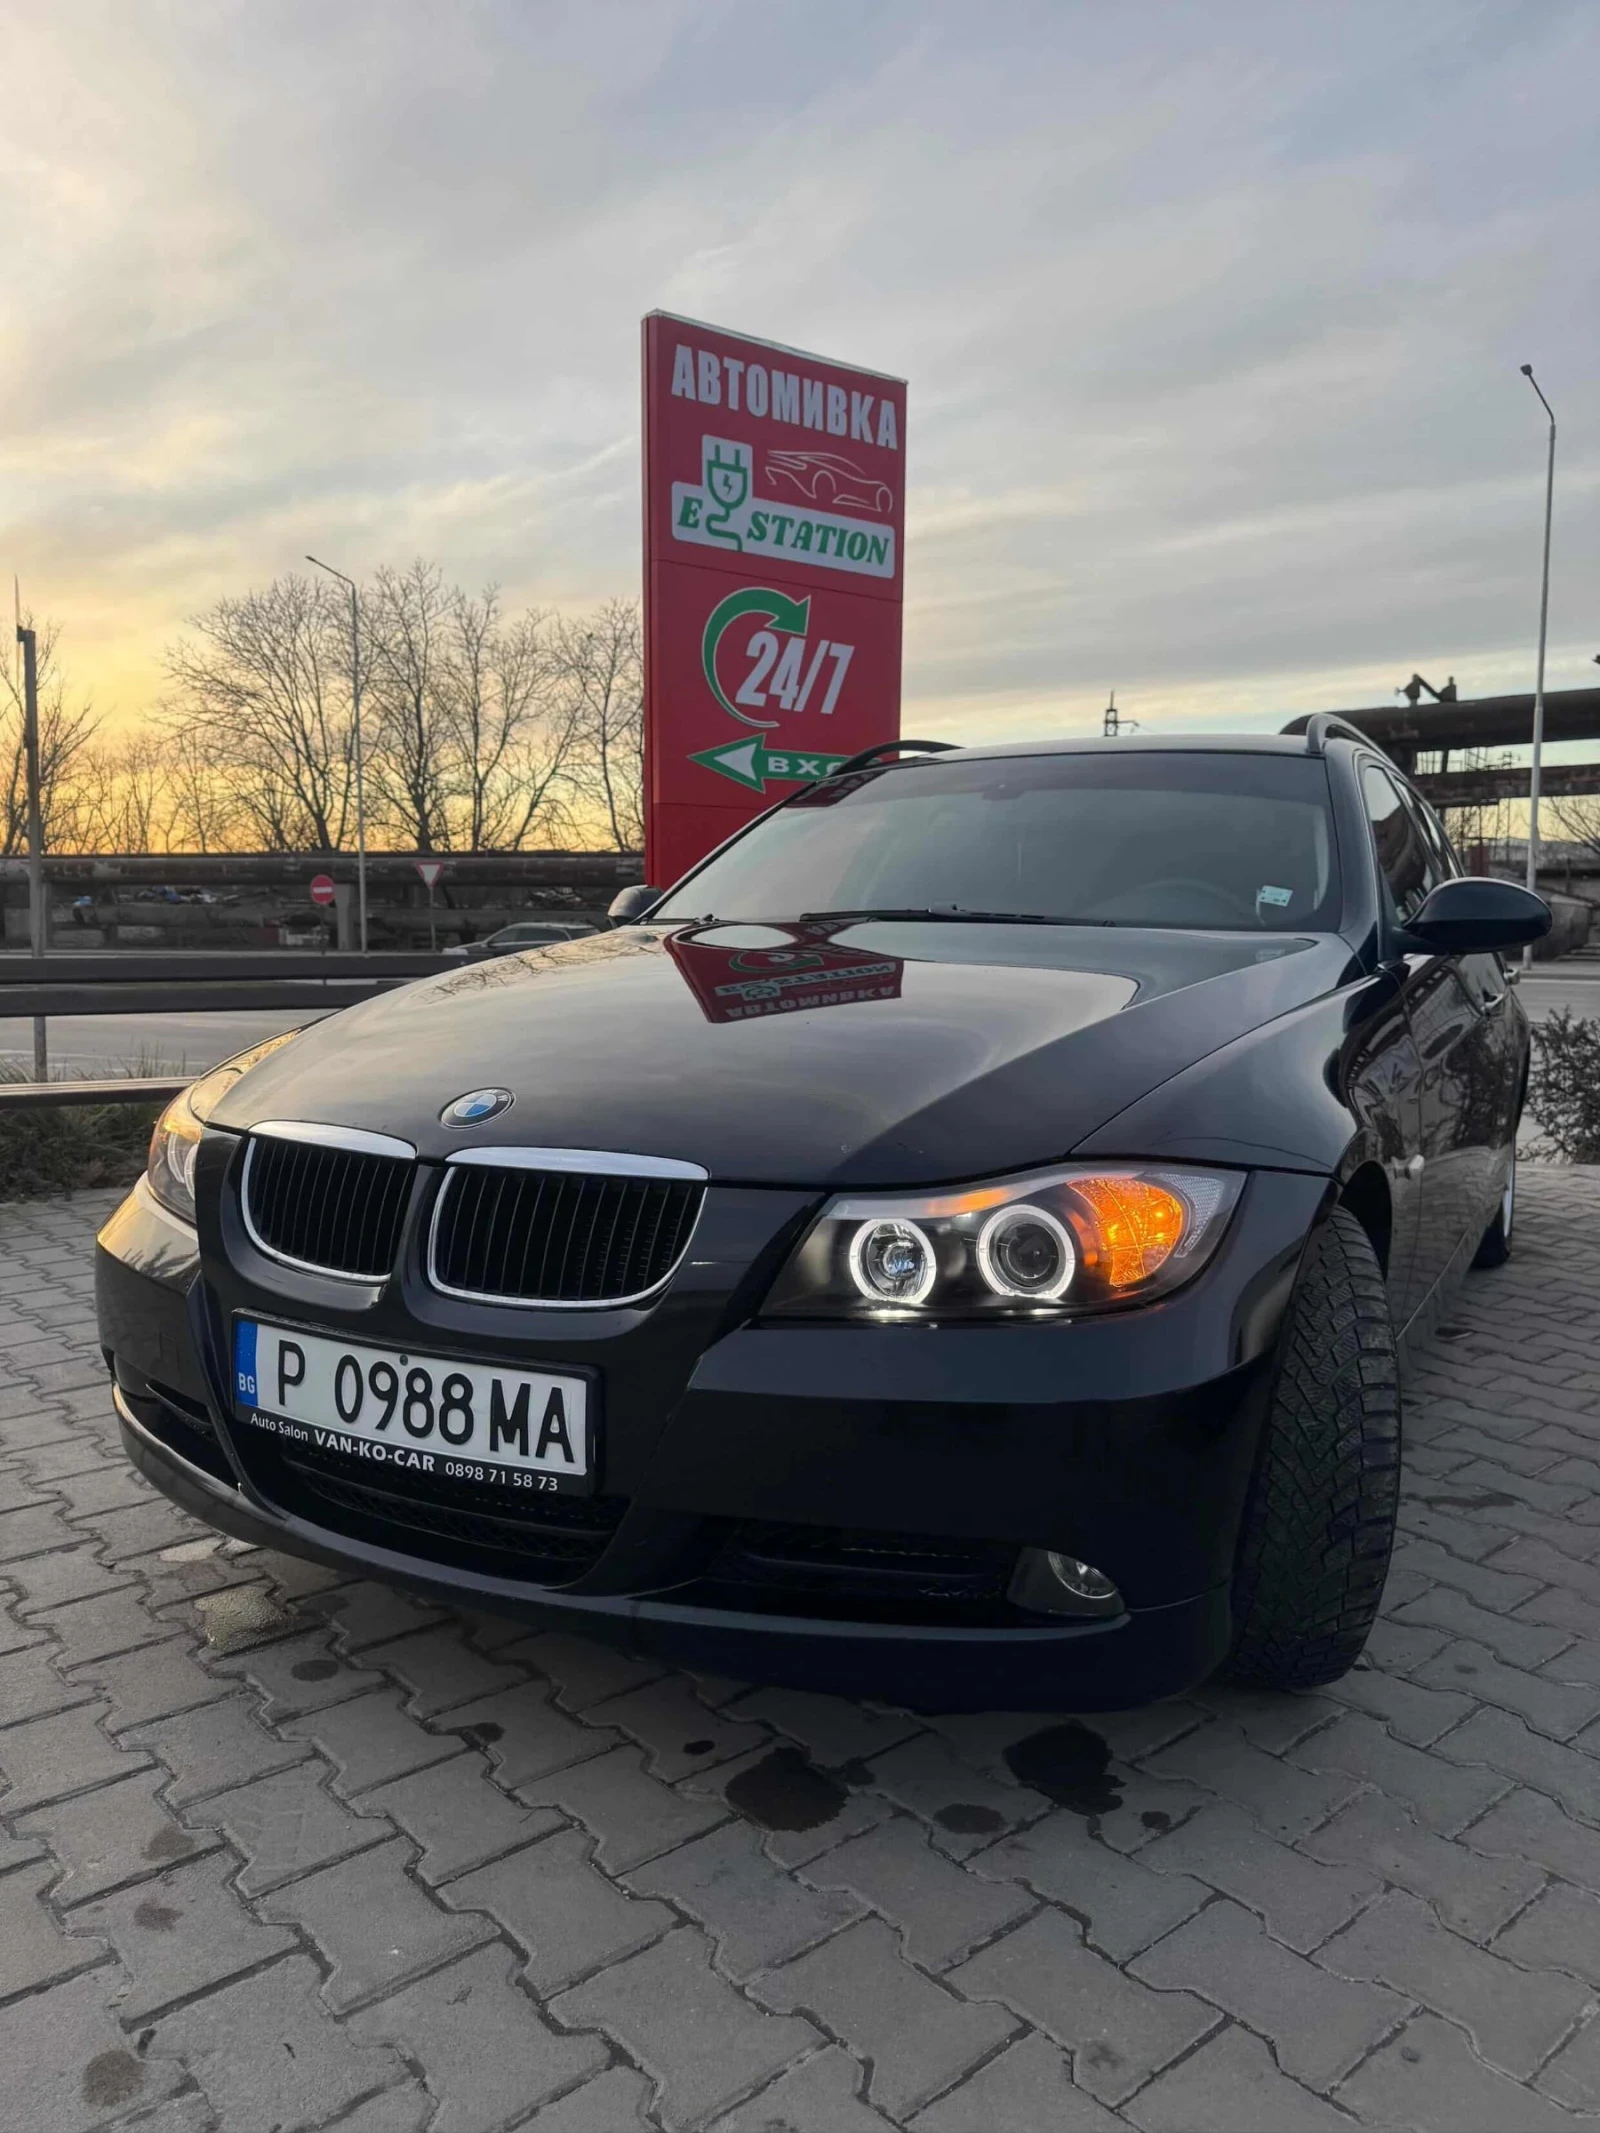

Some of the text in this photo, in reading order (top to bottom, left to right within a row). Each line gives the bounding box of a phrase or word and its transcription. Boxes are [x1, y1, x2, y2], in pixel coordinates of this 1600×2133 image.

[671, 344, 898, 450] АВТОМИВКА
[678, 496, 890, 566] E STATION
[735, 631, 855, 715] 24/7
[238, 1373, 256, 1394] BG
[334, 1354, 474, 1445] 0988
[250, 1412, 558, 1492] Auto Salon VAN-KO-CAR 0898 71 58 73
